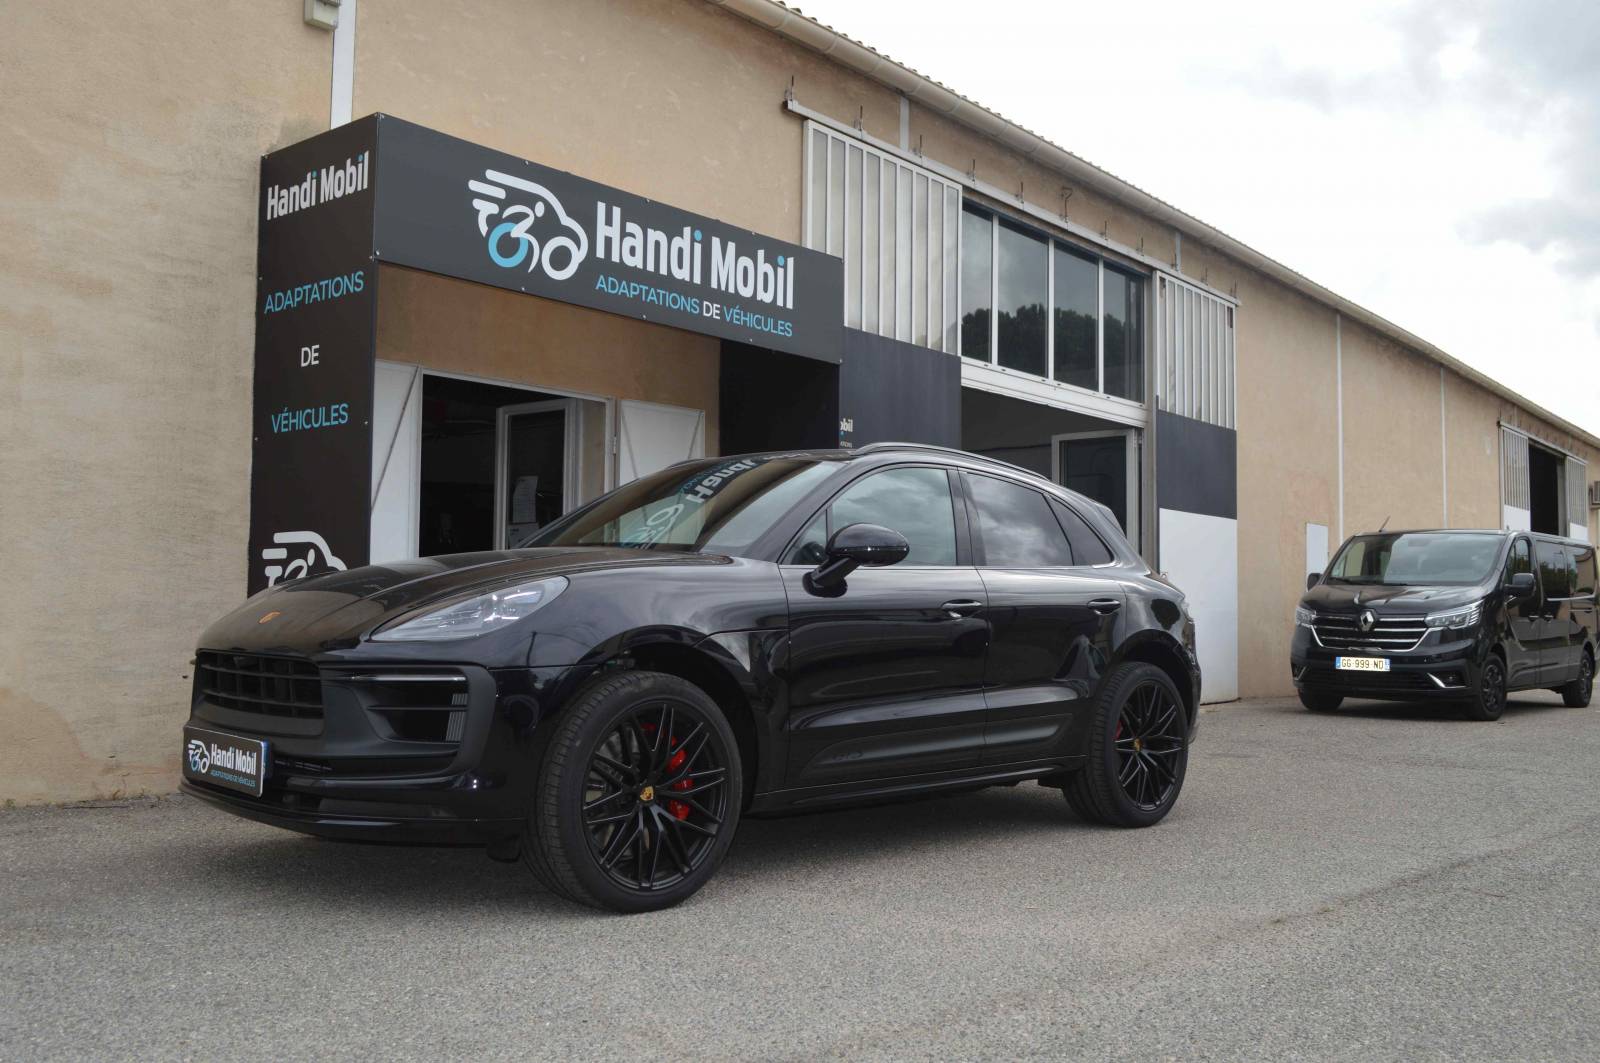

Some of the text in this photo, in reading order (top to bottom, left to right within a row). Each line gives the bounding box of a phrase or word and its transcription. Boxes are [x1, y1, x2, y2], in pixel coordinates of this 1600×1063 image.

[267, 150, 369, 220] Handi Mobil
[595, 201, 794, 310] Handi Mobil
[264, 270, 364, 314] ADAPTATIONS
[595, 275, 793, 337] ADAPTATIONS DE VÉHICULES
[301, 344, 320, 367] DE
[271, 403, 349, 433] VÉHICULES
[211, 744, 256, 775] Handi Mobil
